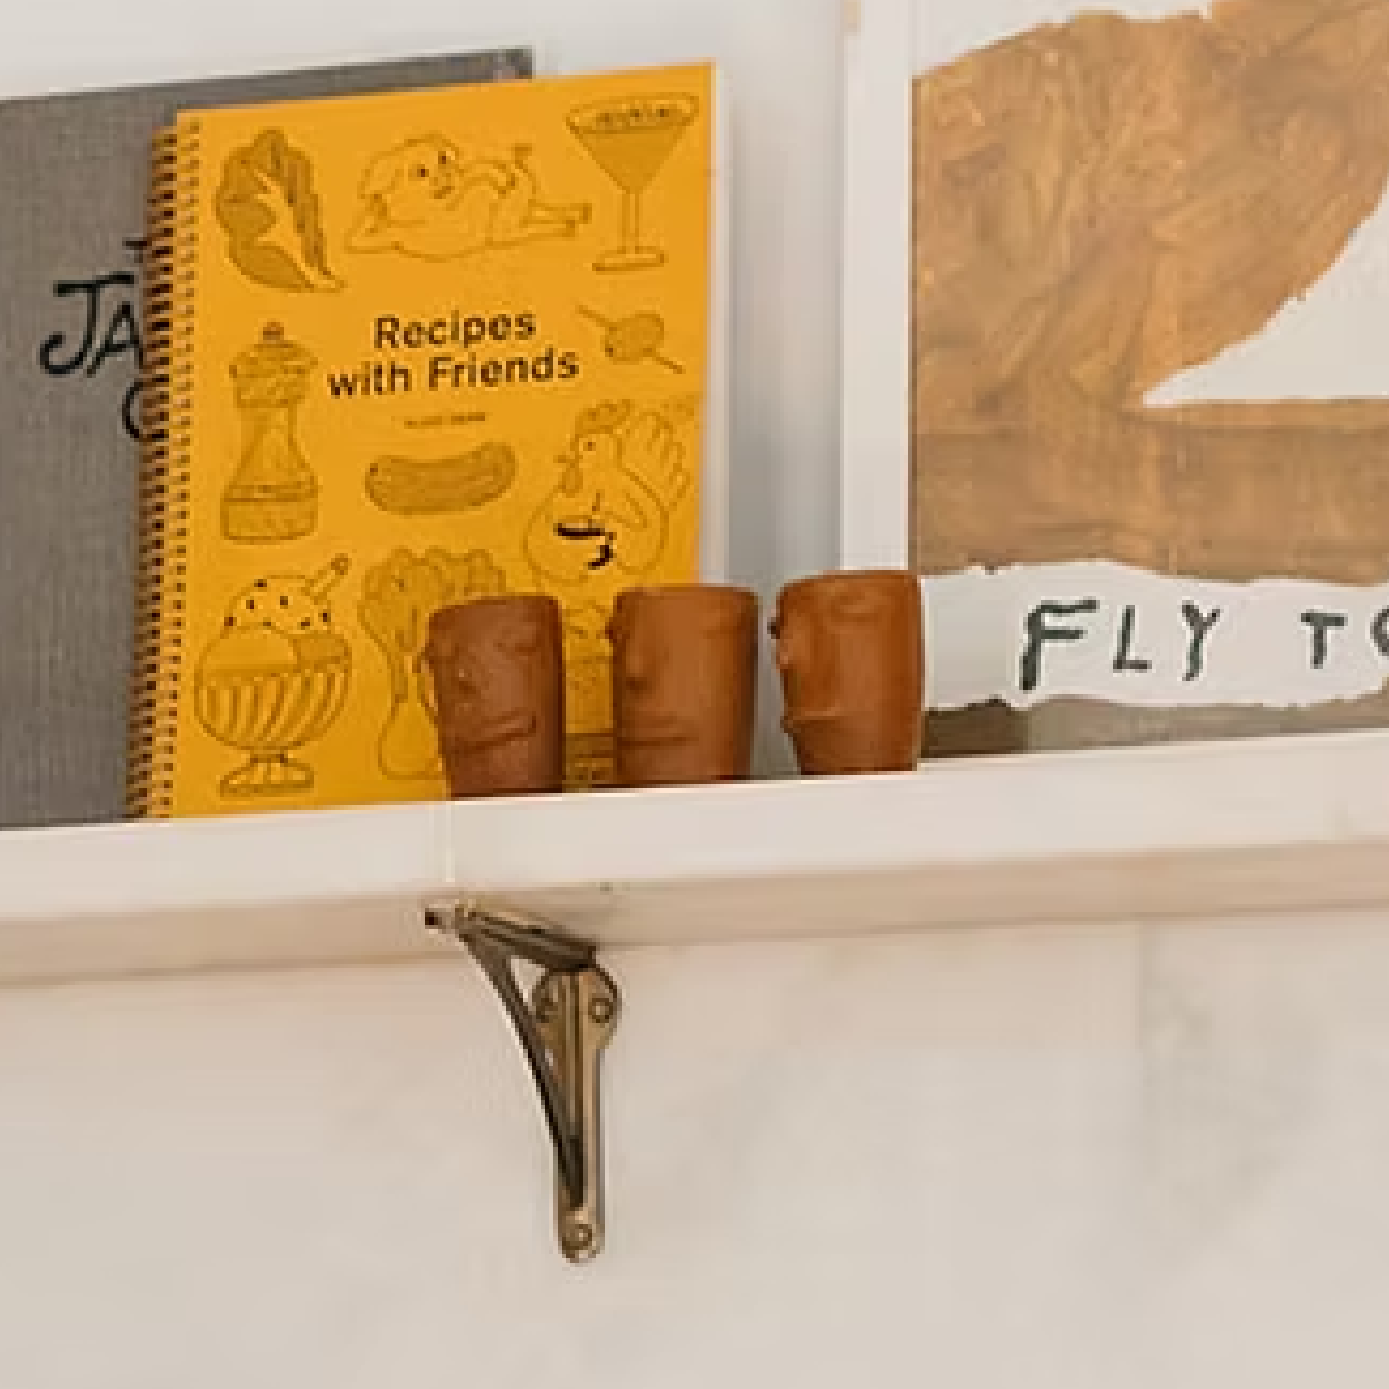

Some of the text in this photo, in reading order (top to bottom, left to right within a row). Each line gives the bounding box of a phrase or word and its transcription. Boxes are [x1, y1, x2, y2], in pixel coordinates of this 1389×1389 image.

[373, 310, 537, 349] Recipes
[326, 347, 580, 399] with Friends
[1020, 597, 1222, 690] FLY
